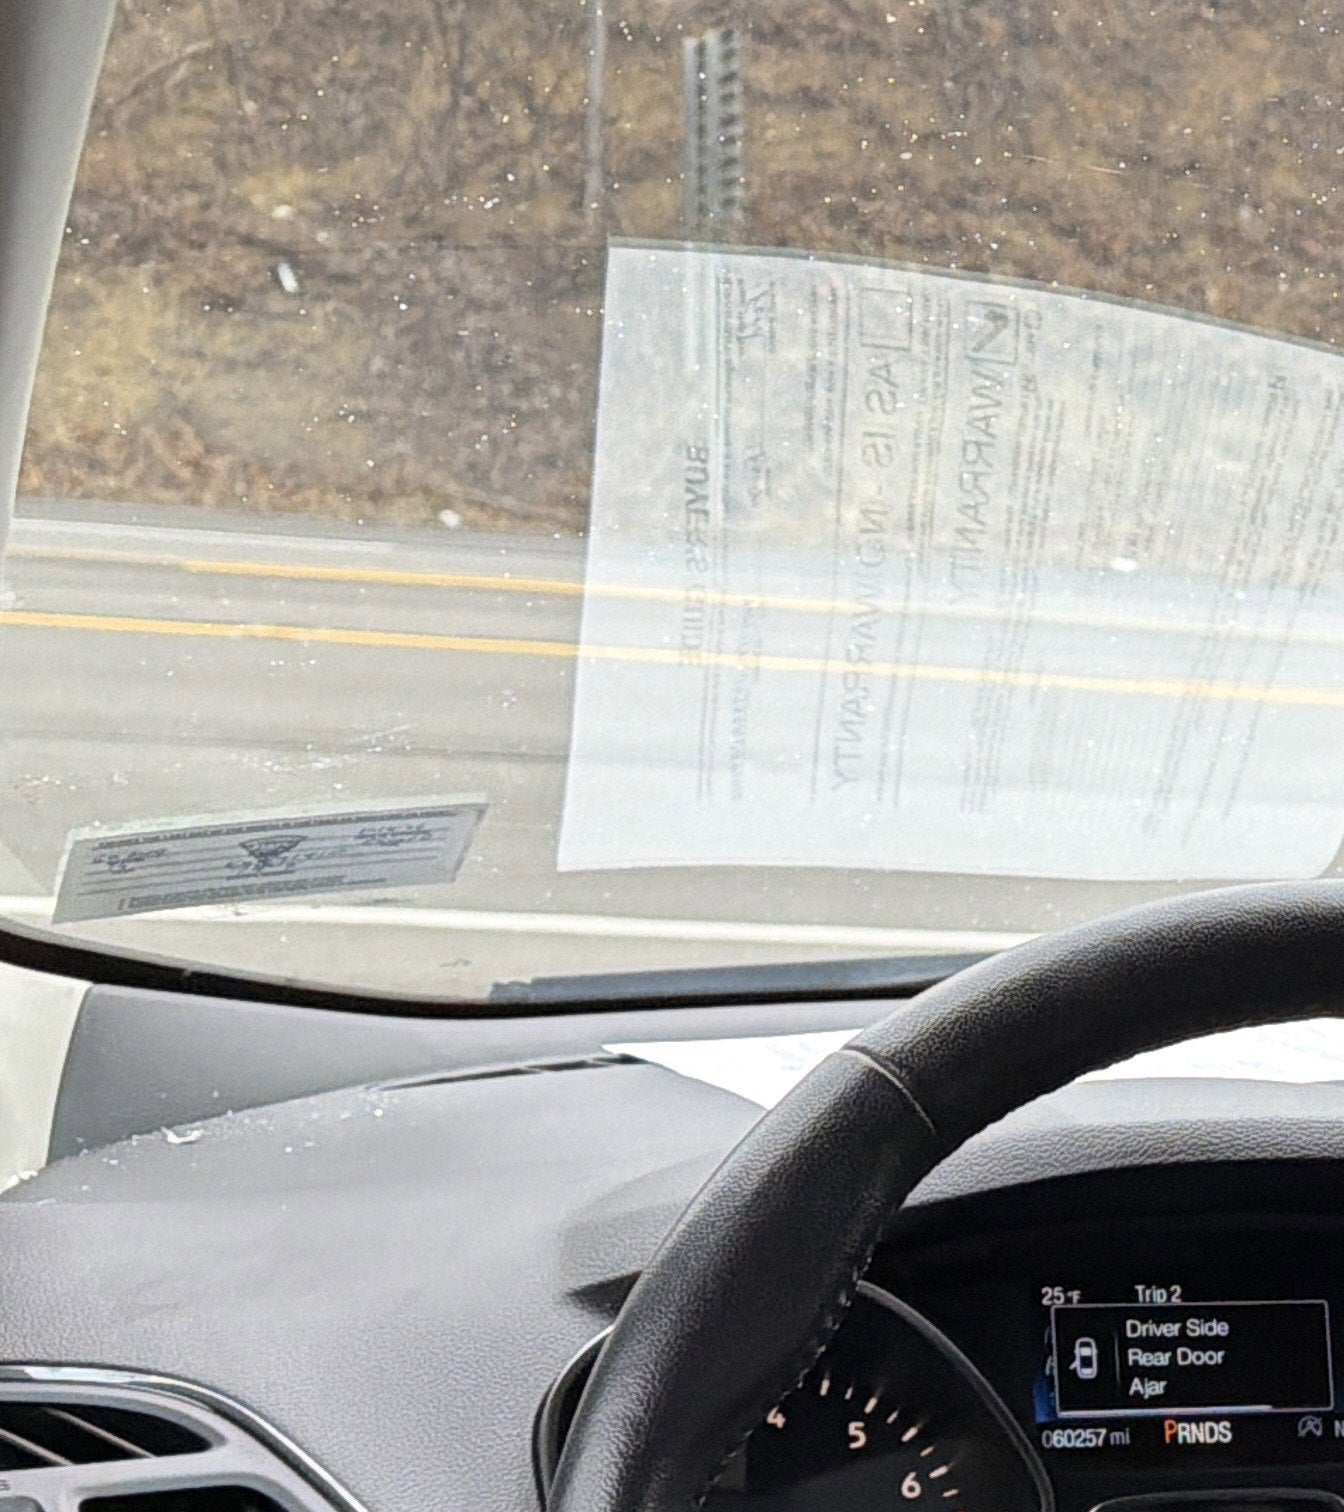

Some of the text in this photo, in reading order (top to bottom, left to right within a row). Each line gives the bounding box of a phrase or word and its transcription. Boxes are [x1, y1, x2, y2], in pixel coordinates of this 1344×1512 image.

[1135, 1285, 1168, 1305] Trip
[1170, 1284, 1182, 1304] 2
[1126, 1318, 1230, 1339] Driver Side
[1128, 1347, 1225, 1367] Rear Door
[1129, 1376, 1168, 1399] Ajar
[766, 1405, 787, 1430] 4
[847, 1420, 868, 1450] 5
[1041, 1427, 1131, 1449] 060257 mi
[1164, 1419, 1233, 1444] PRNDS
[900, 1471, 922, 1500] 6
